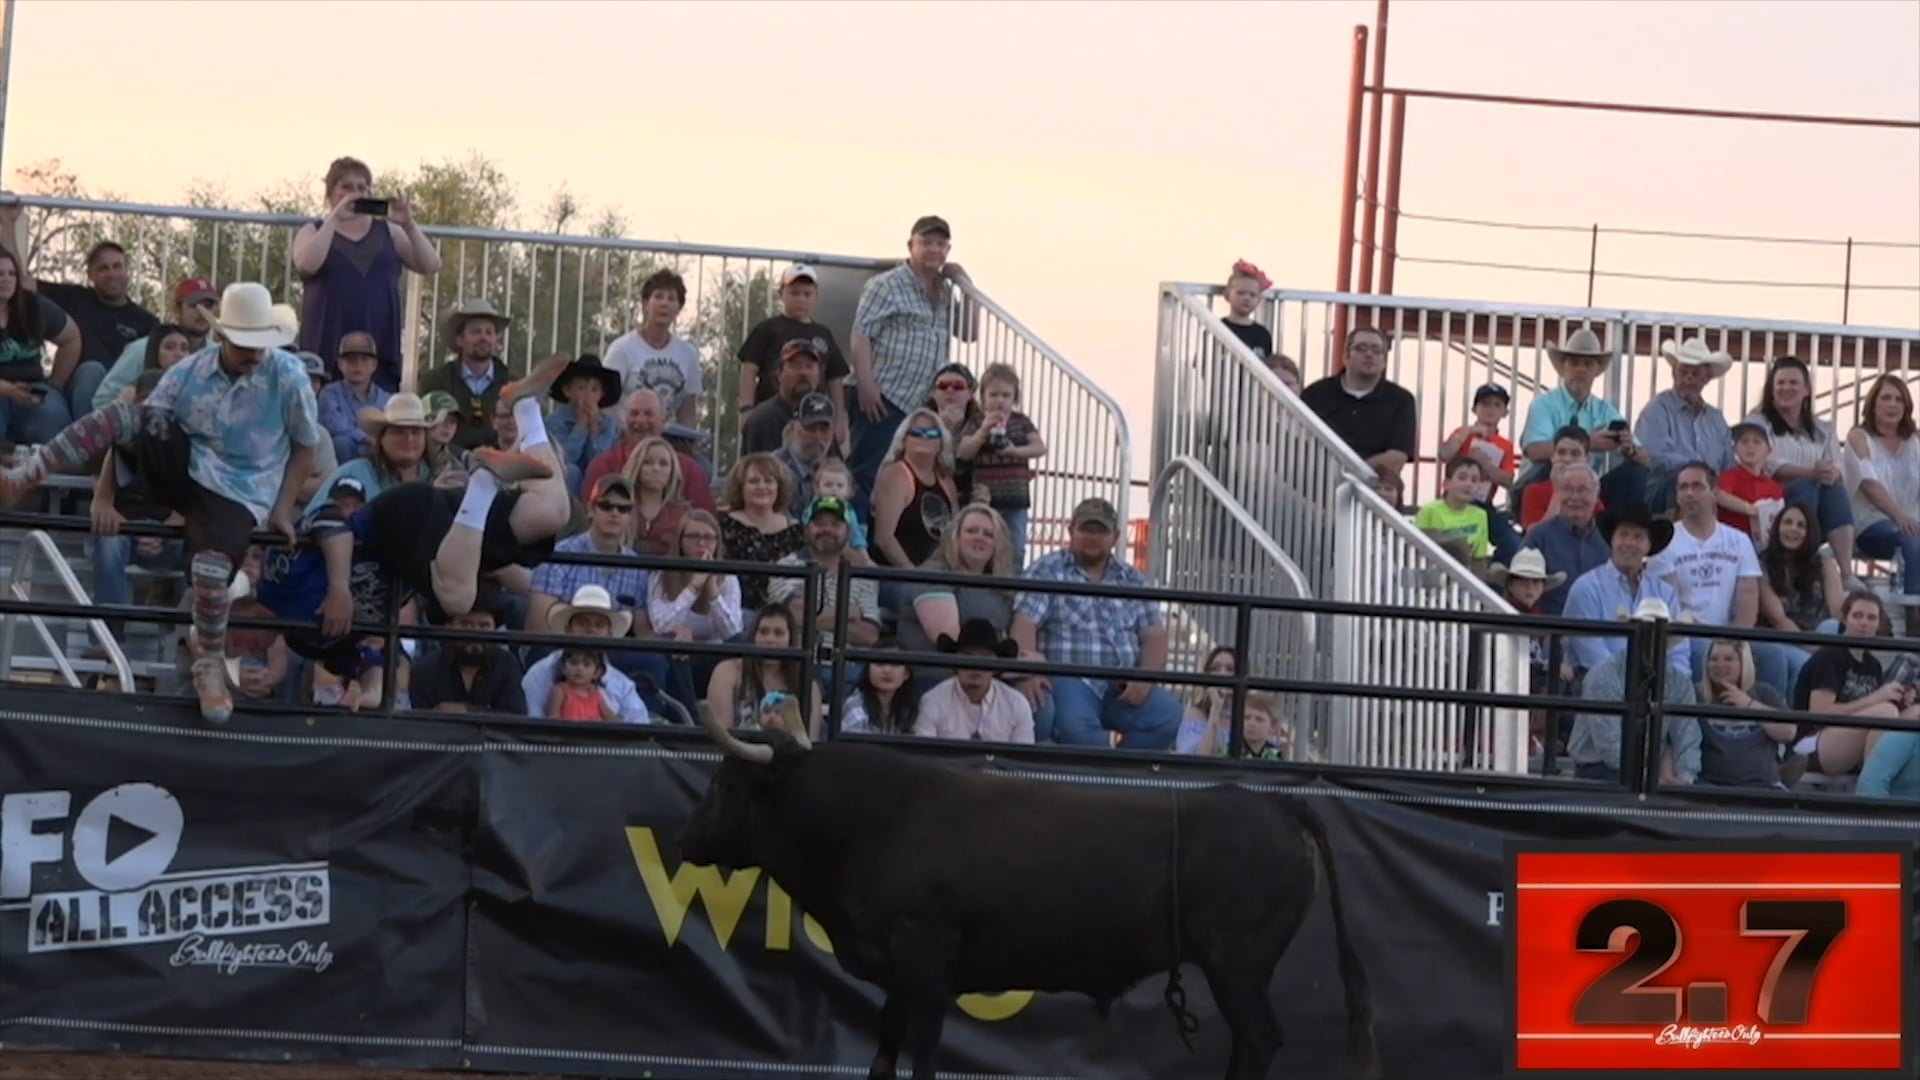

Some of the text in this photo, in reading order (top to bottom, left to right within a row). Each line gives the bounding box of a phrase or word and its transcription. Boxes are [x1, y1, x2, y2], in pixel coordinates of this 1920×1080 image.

[35, 875, 324, 945] ALL ACCESS
[287, 940, 333, 973] Only
